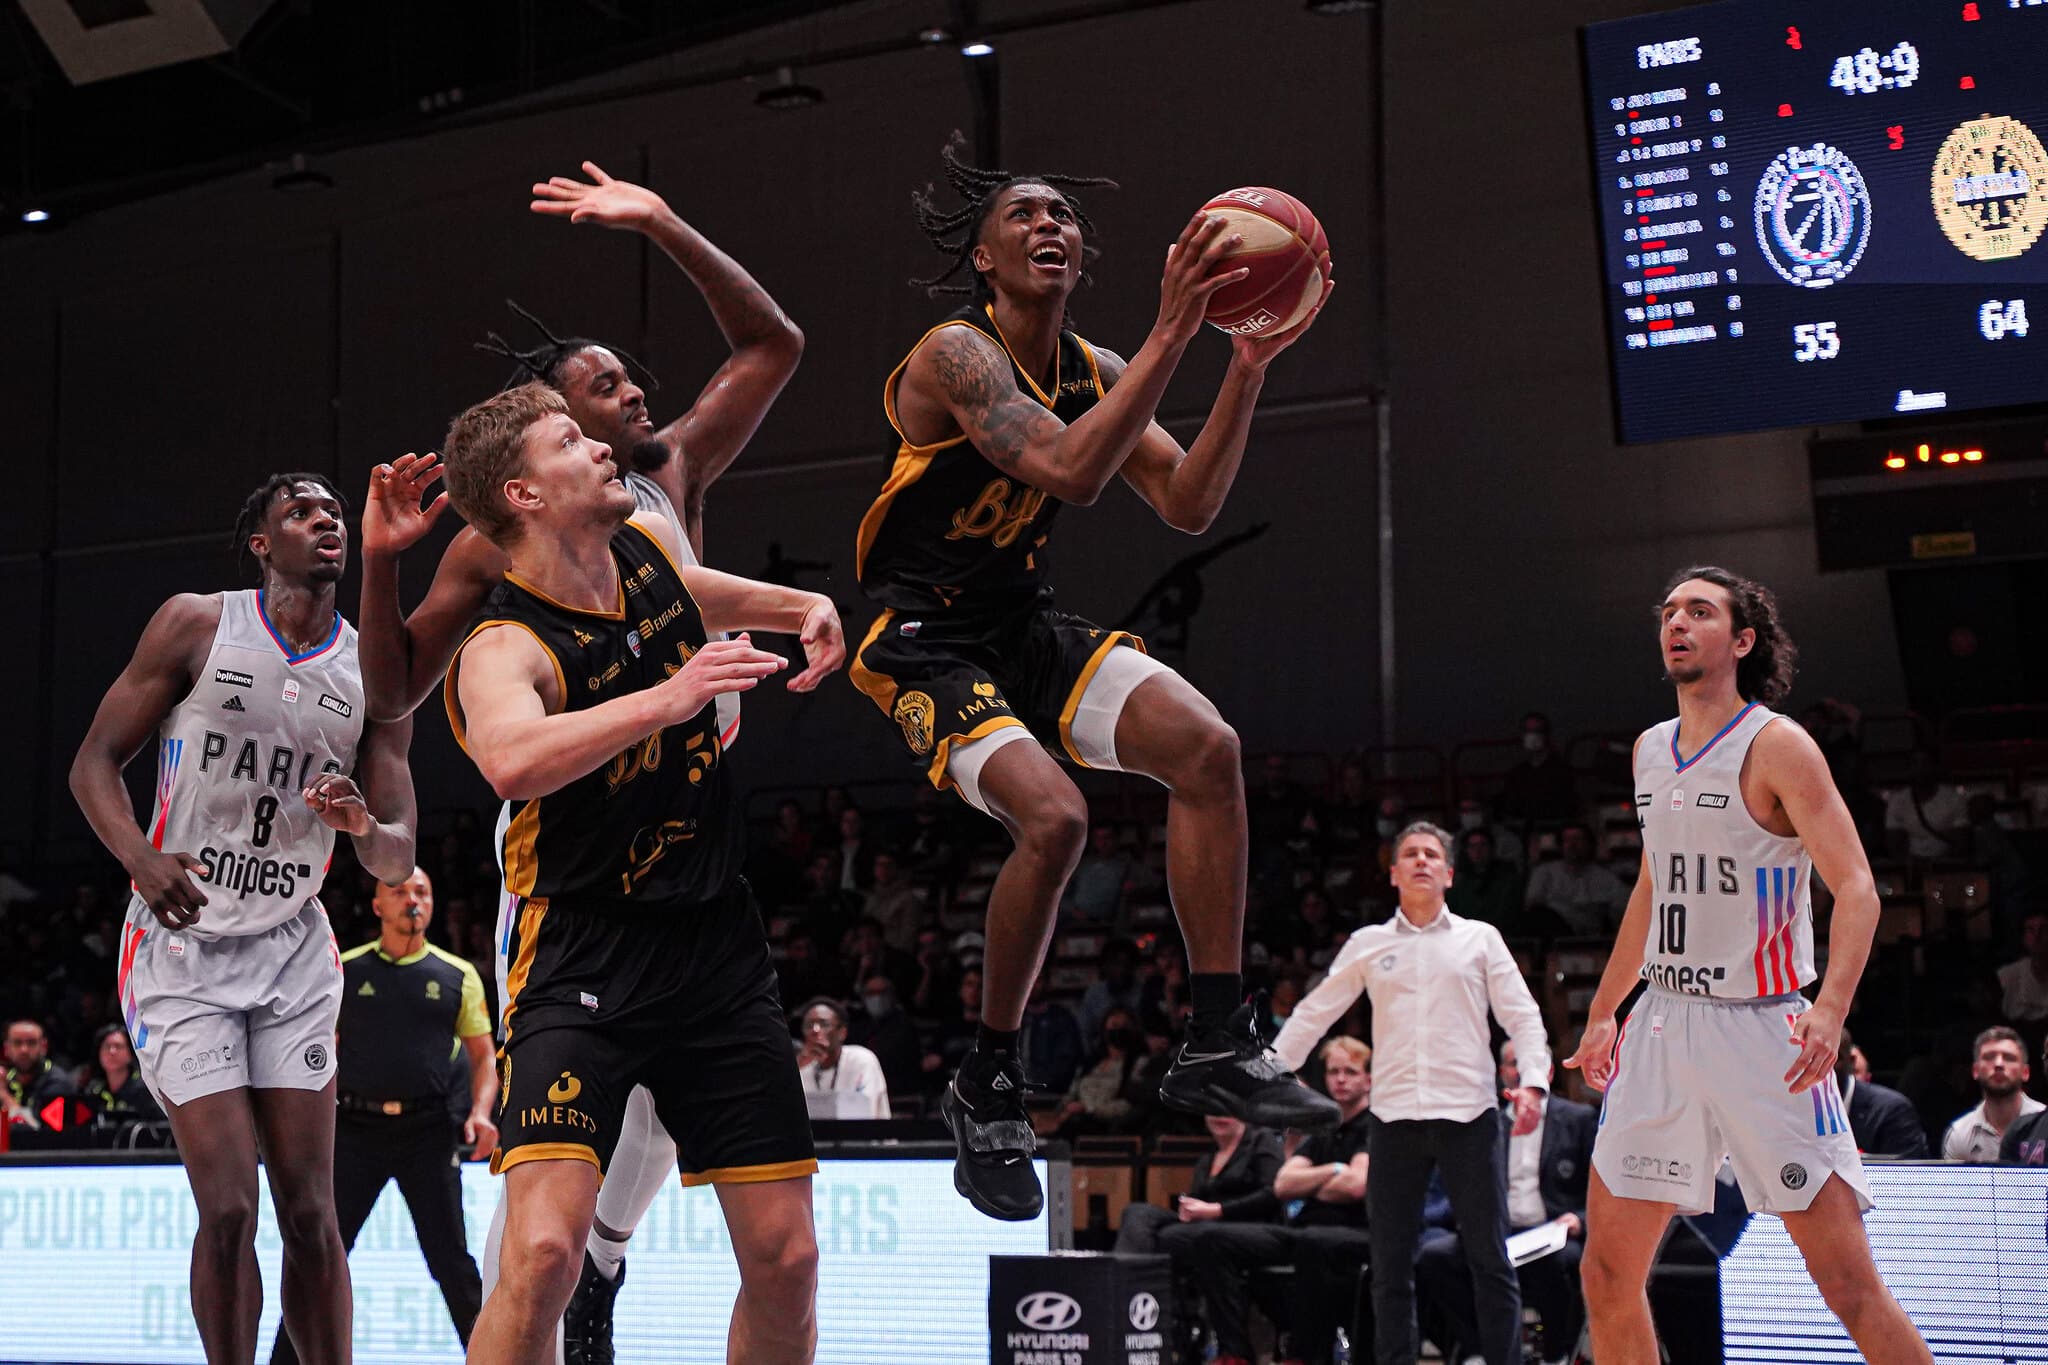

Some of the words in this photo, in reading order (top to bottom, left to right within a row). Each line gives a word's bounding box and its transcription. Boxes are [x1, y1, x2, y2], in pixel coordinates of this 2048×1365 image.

[1793, 321, 1841, 362] 55
[1979, 299, 2029, 341] 64
[199, 730, 341, 791] PARI
[252, 795, 279, 848] 8
[200, 846, 296, 900] snipes
[1658, 903, 1686, 955] 10
[1007, 1332, 1089, 1350] HYUNDAI
